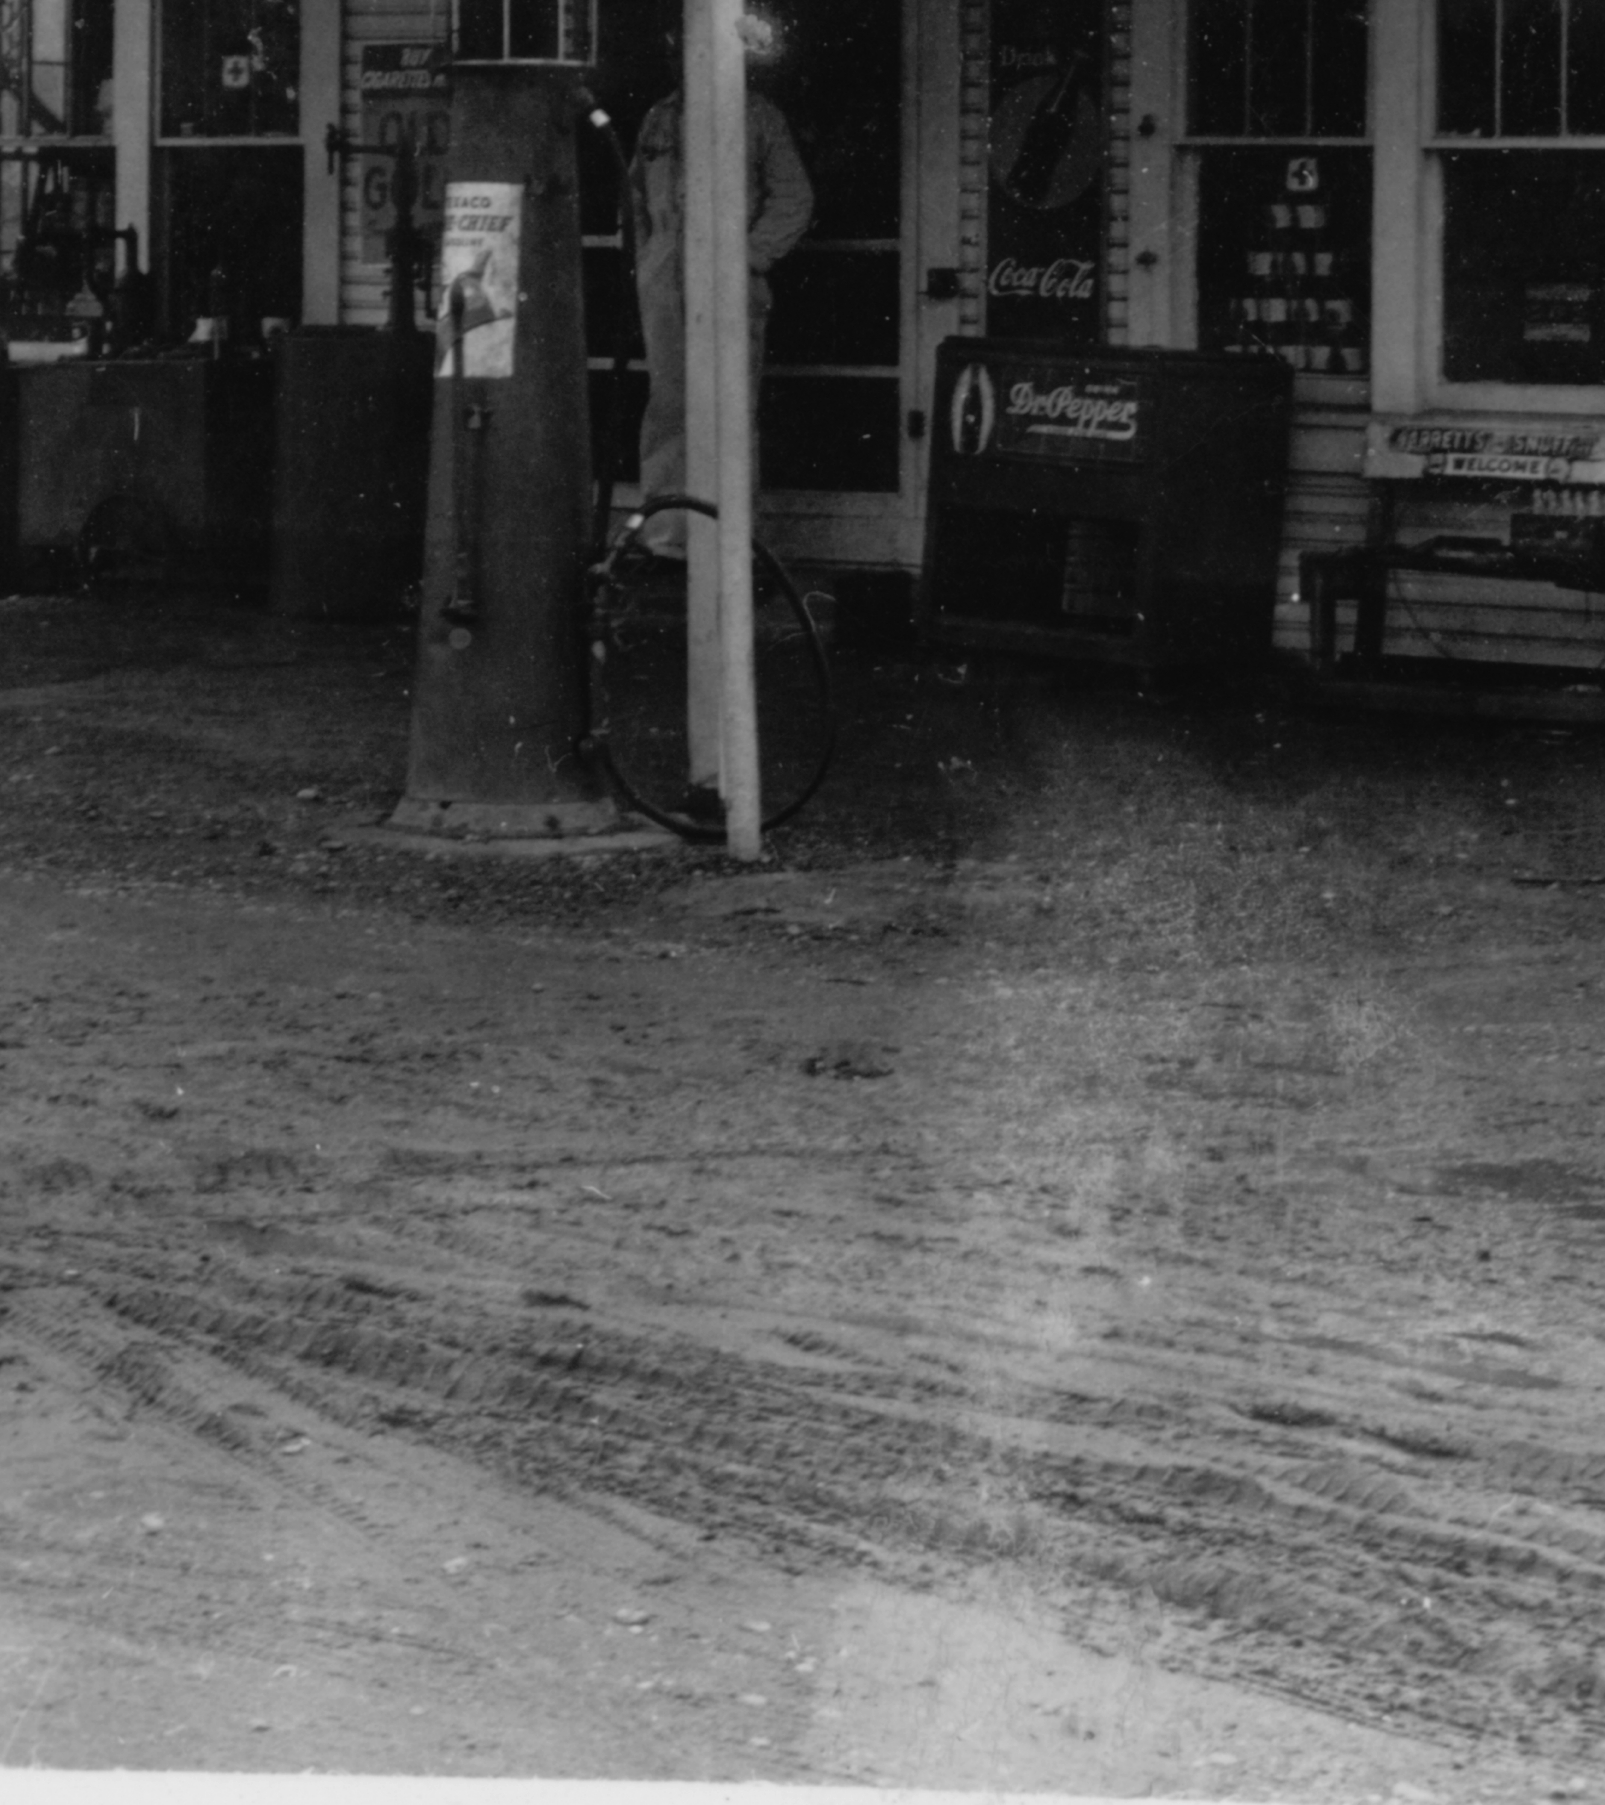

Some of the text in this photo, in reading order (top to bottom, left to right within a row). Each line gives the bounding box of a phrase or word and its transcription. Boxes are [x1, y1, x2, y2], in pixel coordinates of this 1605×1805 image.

[445, 196, 492, 209] EXACO
[444, 214, 514, 233] E-CHIEF
[986, 257, 1096, 299] Coca-Cola
[1453, 456, 1540, 474] WELCOME
